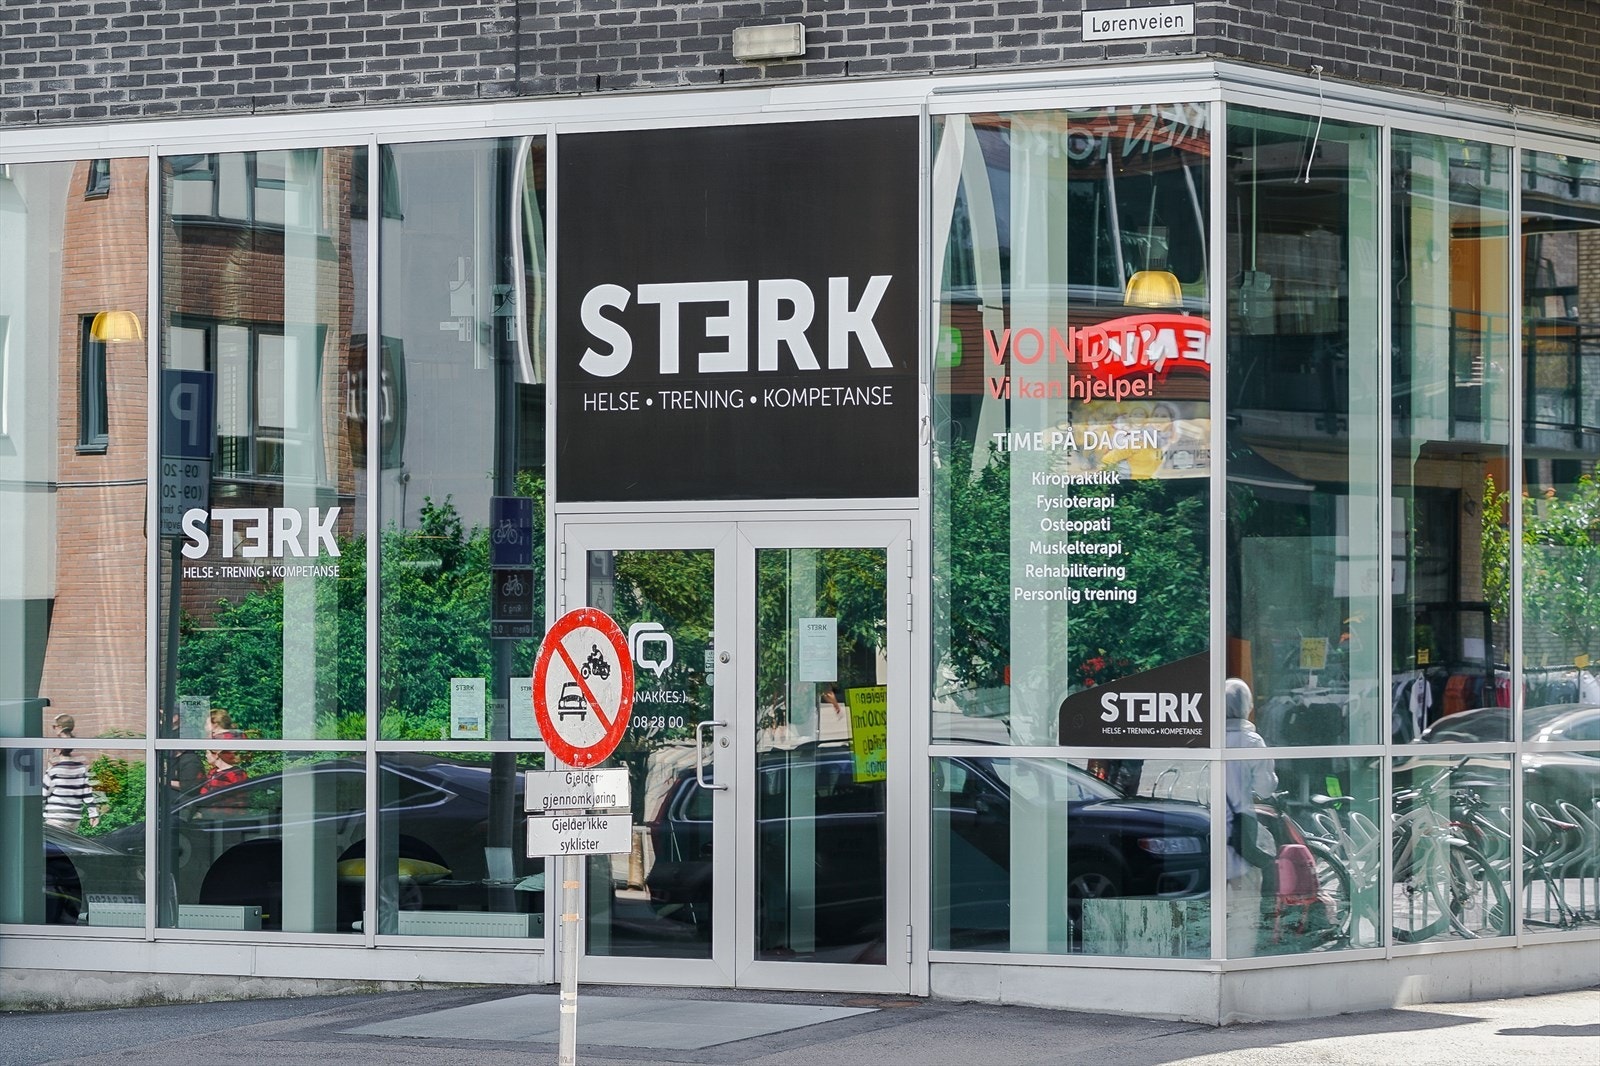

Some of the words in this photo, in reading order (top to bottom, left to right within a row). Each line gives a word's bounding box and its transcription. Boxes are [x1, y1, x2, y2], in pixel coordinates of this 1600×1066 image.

[1092, 12, 1184, 33] Lørenveien
[578, 275, 894, 377] STERK
[983, 323, 1158, 366] VONDT?
[987, 375, 1011, 400] Vi
[1018, 375, 1063, 399] kan
[1070, 373, 1154, 404] hjelpe!
[583, 391, 640, 411] HELSE
[658, 389, 744, 410] TRENING
[763, 386, 894, 408] KOMPETANSE
[992, 432, 1045, 453] TIME
[1051, 426, 1078, 451] PÅ
[1083, 430, 1159, 451] DAGEN
[1031, 471, 1121, 489] Kiropraktikk
[1036, 493, 1115, 512] Fysioterapi
[180, 506, 342, 560] STERK
[1040, 516, 1111, 535] Osteopati
[1029, 539, 1122, 558] Muskelterapi
[183, 566, 214, 578] HELSE
[220, 566, 265, 578] TRENING
[272, 565, 340, 578] KOMPETANSE
[1025, 563, 1126, 581] Rehabilitering
[1014, 586, 1081, 605] Personlig
[1085, 586, 1138, 605] trening
[1100, 691, 1203, 723] STERK
[633, 716, 649, 729] 08
[651, 716, 665, 729] 28
[668, 715, 684, 729] 00
[1102, 727, 1121, 735] HELSE
[1126, 727, 1155, 735] TRENING
[1160, 727, 1203, 736] KOMPETANSE
[565, 772, 600, 787] Gjelder
[542, 793, 616, 809] gjennomkjøring
[551, 818, 586, 834] Gjelder
[588, 818, 608, 831] ikke
[560, 839, 600, 853] syklister
